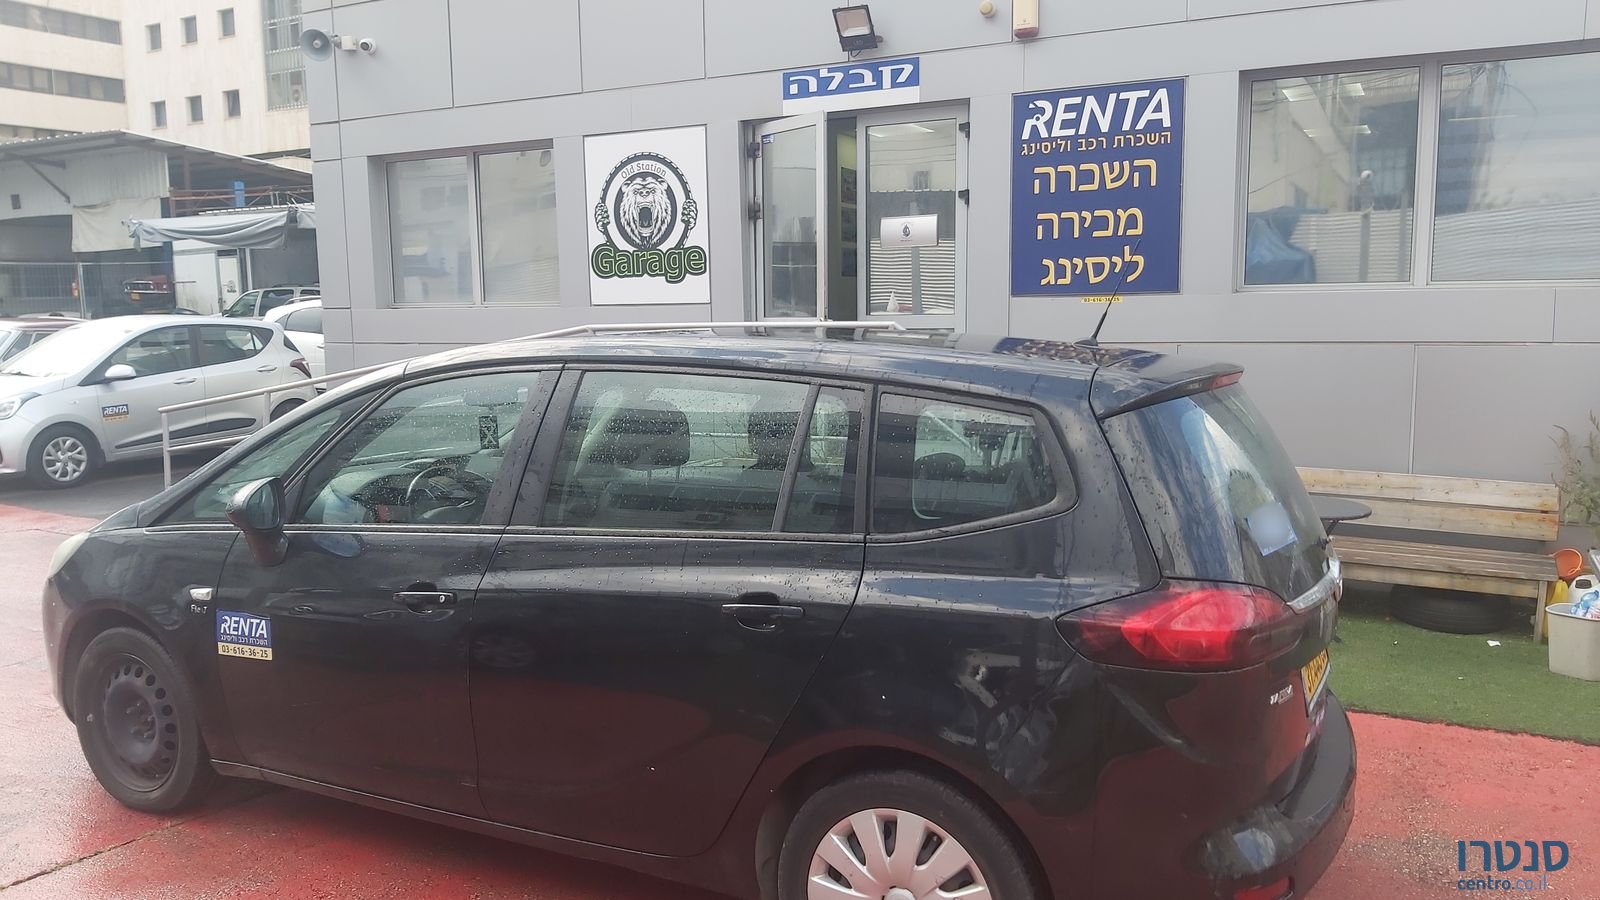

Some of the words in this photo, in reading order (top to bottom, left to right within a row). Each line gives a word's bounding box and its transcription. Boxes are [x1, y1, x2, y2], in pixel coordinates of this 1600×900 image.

[789, 64, 914, 95] קבלה
[1021, 88, 1172, 140] RENTA
[1021, 139, 1071, 156] וליסינג
[1078, 137, 1107, 151] רכב
[1113, 131, 1171, 149] השכרת
[621, 167, 636, 180] Old
[636, 162, 667, 178] Station
[1033, 158, 1157, 195] השכרה
[1036, 207, 1144, 241] מכירה
[592, 243, 706, 283] Garage
[1040, 245, 1145, 286] ליסינג
[103, 406, 128, 416] RENTA
[220, 615, 268, 639] RENTA
[221, 645, 269, 658] 03-616-36-25
